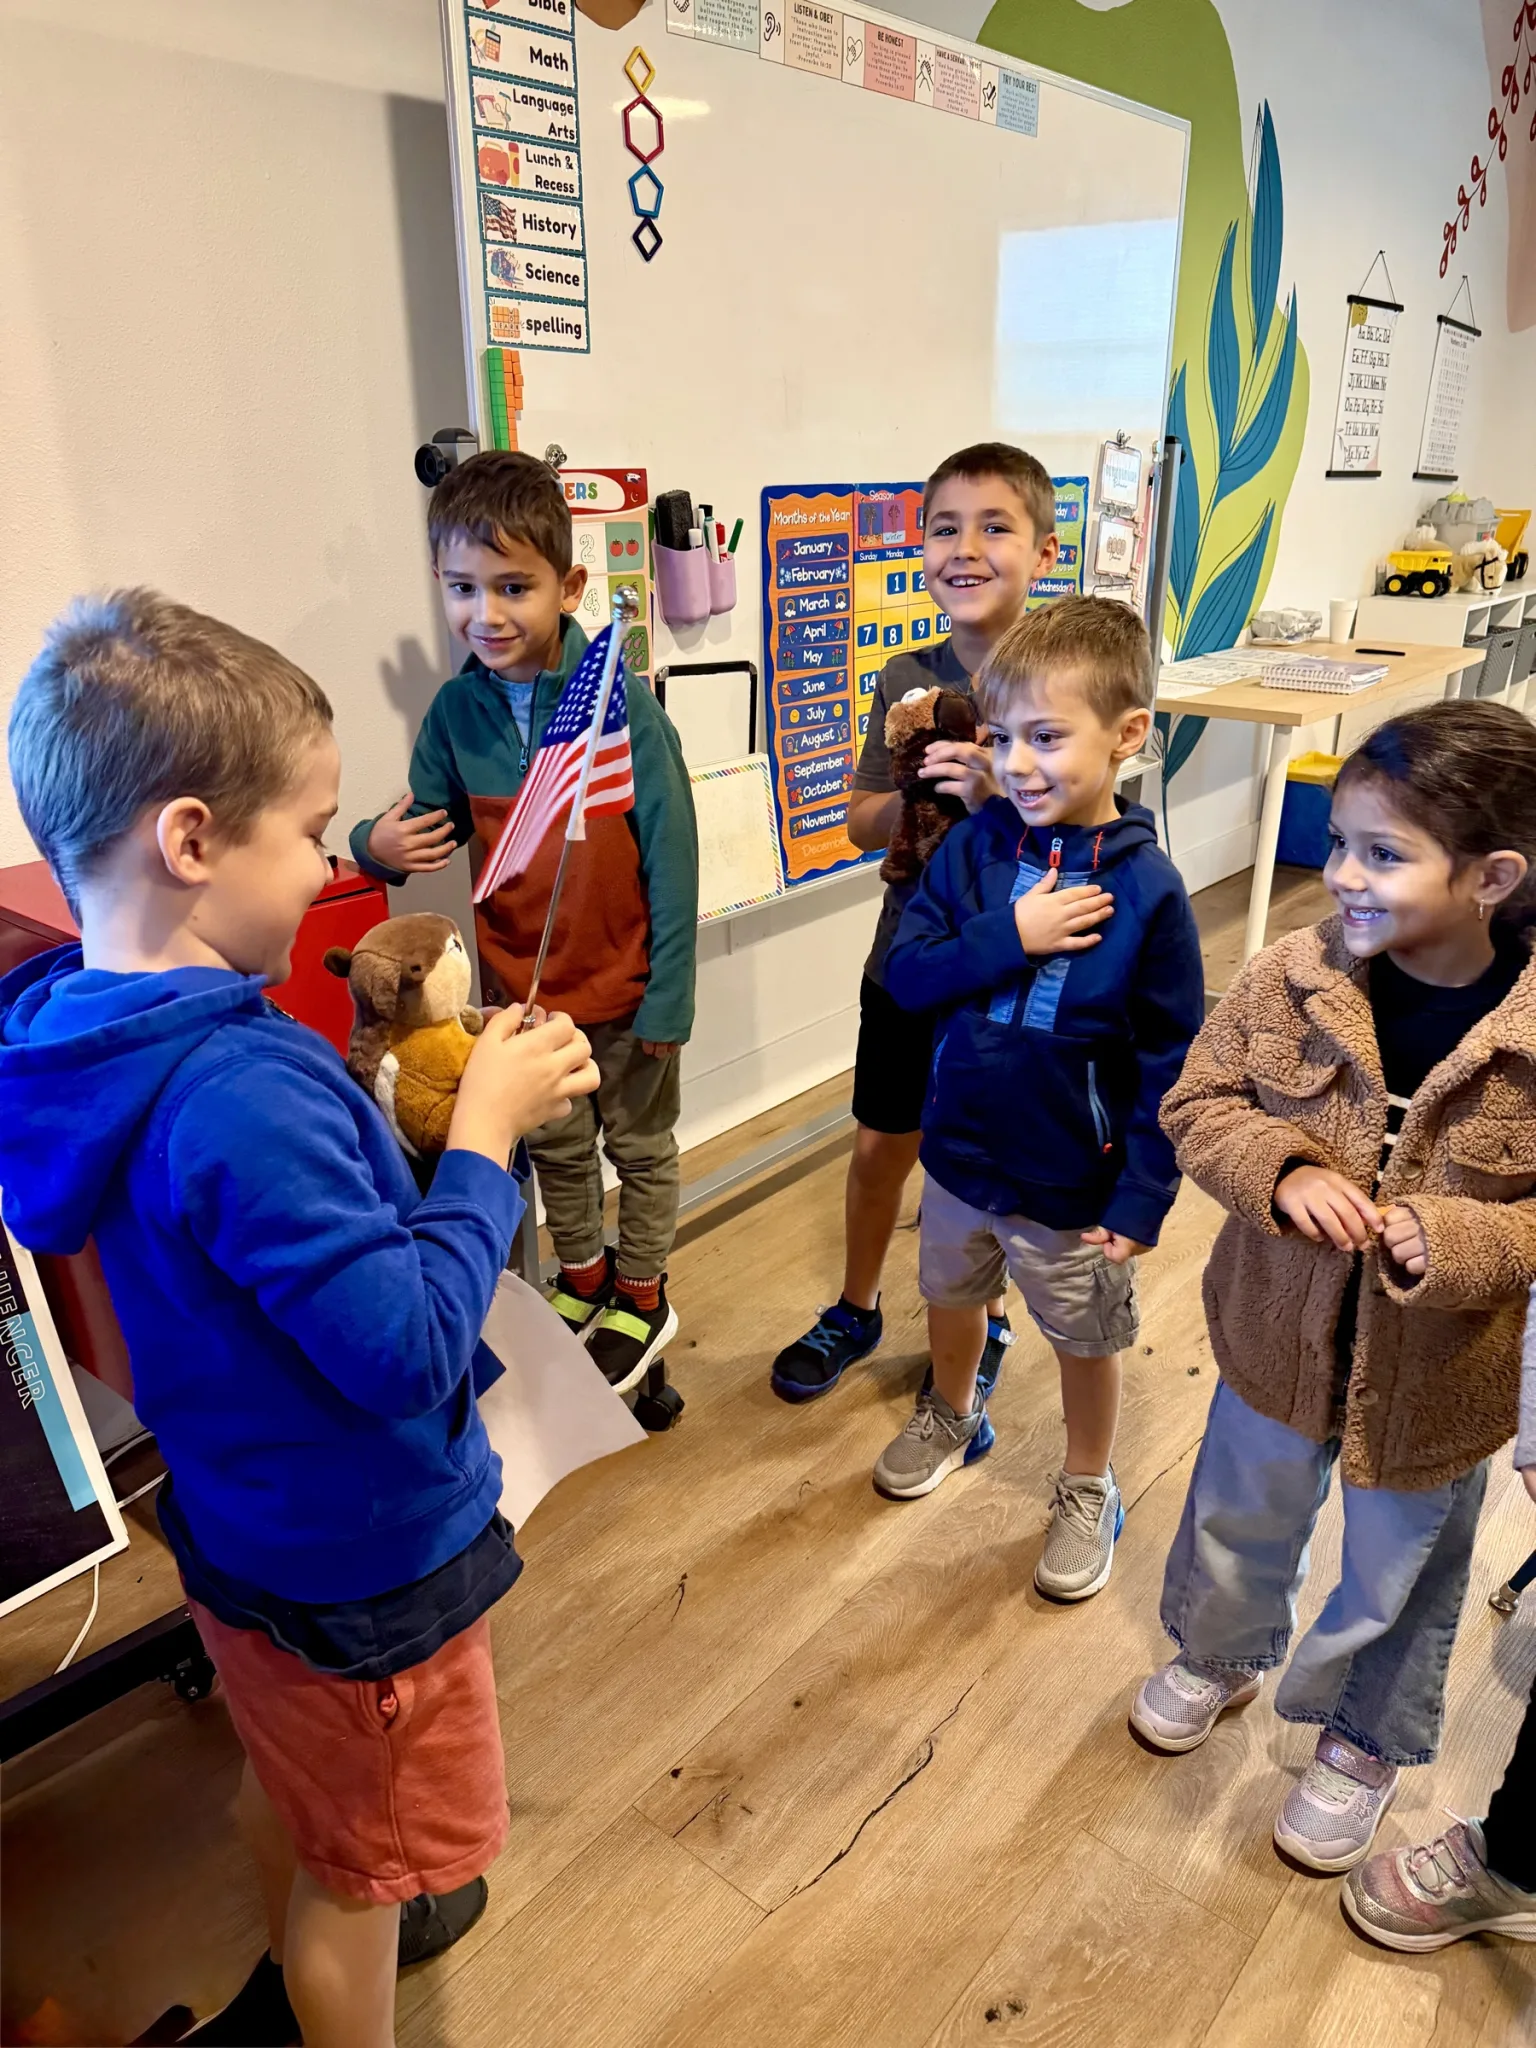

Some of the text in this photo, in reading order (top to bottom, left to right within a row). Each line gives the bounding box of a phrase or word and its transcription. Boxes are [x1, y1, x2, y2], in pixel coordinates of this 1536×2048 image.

[794, 3, 833, 24] LISTEN & OBEY
[877, 31, 904, 48] BE HONEST
[529, 46, 569, 72] Math
[1002, 73, 1037, 95] TRY YOUR BEST
[513, 88, 574, 117] Language
[548, 122, 575, 140] Arts
[525, 148, 574, 170] Lunch &
[535, 174, 575, 194] Recess
[522, 213, 577, 240] History
[525, 263, 580, 287] Science
[526, 316, 582, 339] spelling
[869, 490, 895, 501] Season
[773, 508, 851, 526] Months of the Year
[579, 534, 596, 563] 2
[793, 540, 833, 556] January
[859, 552, 878, 562] Sunday
[886, 549, 905, 559] Monday
[791, 567, 835, 583] February
[894, 574, 900, 592] 1
[918, 572, 926, 590] 2
[583, 588, 600, 617] 4
[799, 593, 830, 612] March
[802, 622, 827, 639] April
[918, 620, 926, 638] 9
[939, 615, 951, 632] 10
[863, 626, 872, 644] 7
[889, 628, 897, 644] 8
[803, 650, 823, 669] May
[802, 680, 826, 695] June
[863, 673, 876, 693] 14
[806, 706, 826, 722] July
[801, 727, 835, 749] August
[793, 755, 845, 779] September
[803, 779, 842, 799] October
[801, 807, 846, 830] November
